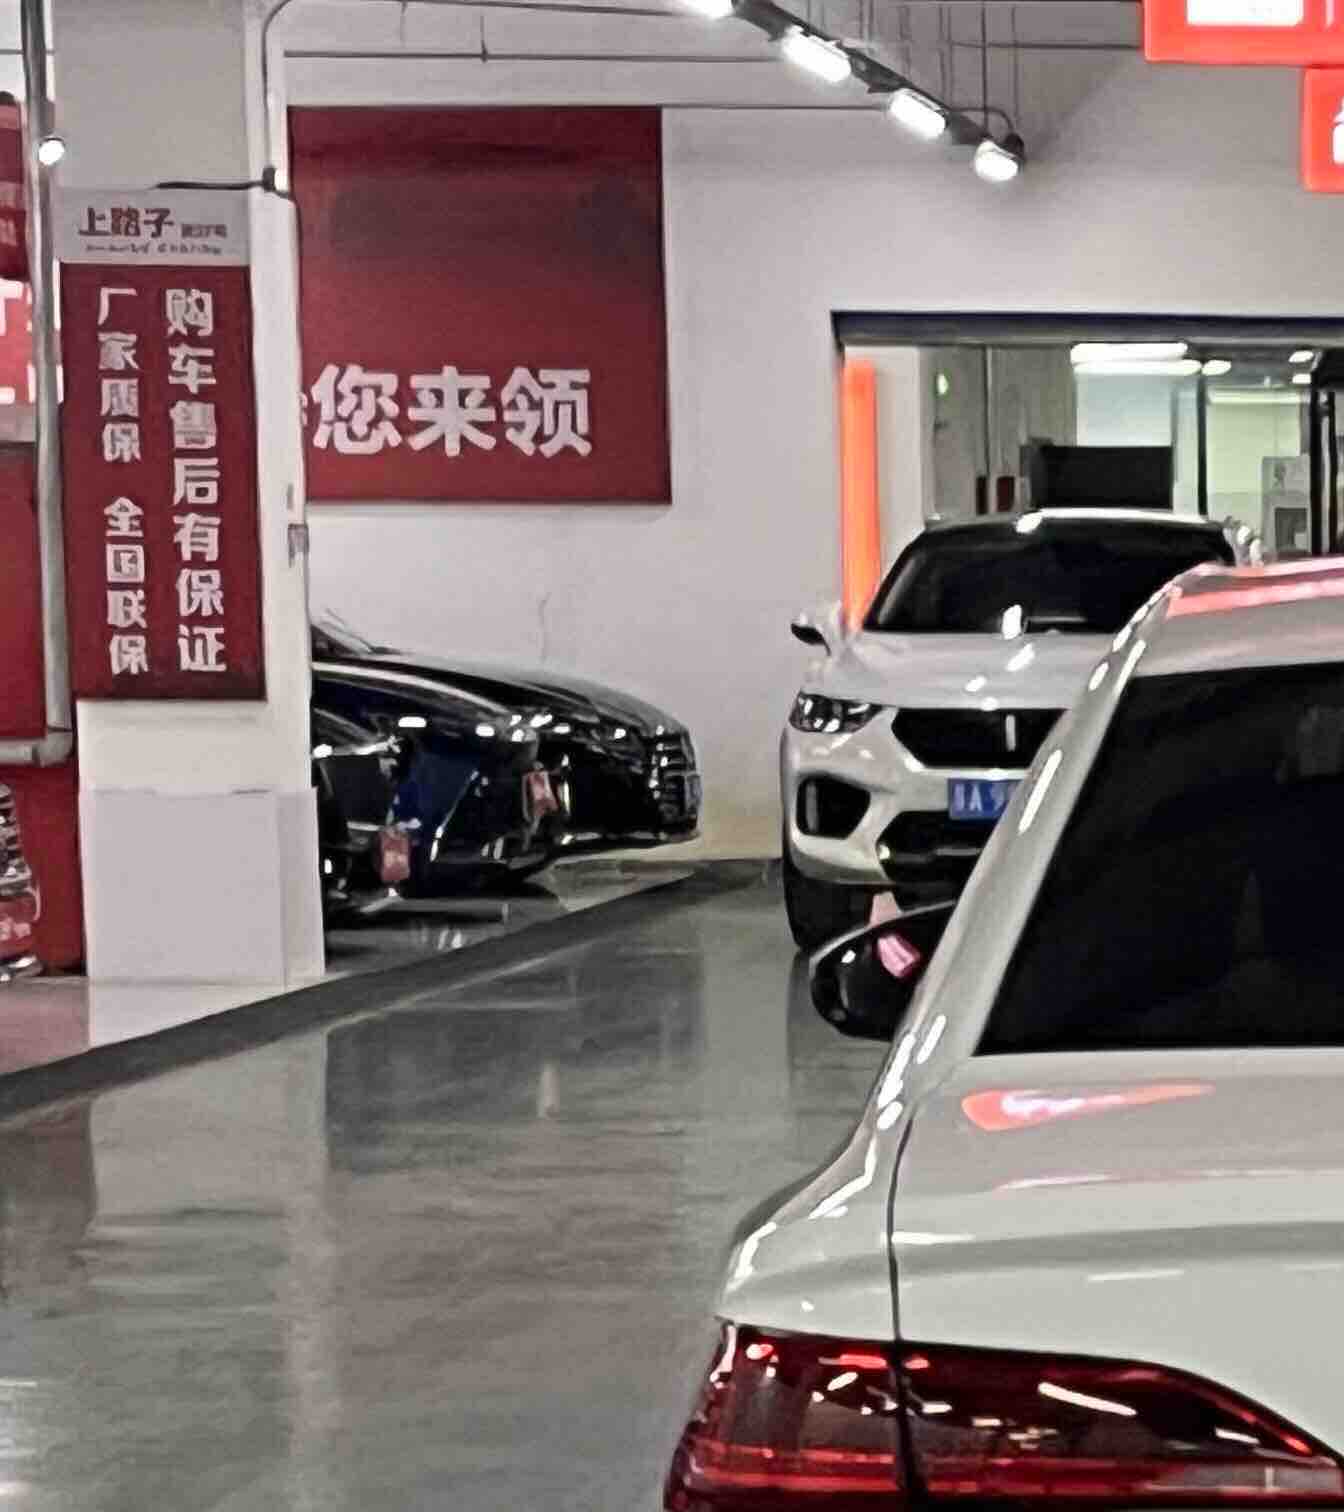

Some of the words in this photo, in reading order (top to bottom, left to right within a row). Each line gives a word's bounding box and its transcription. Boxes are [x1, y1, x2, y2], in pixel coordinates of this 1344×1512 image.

[79, 206, 174, 238] 上路子
[299, 364, 593, 458] 您来领
[166, 288, 227, 674] 购车售后有保证
[103, 497, 150, 676] 全国联保
